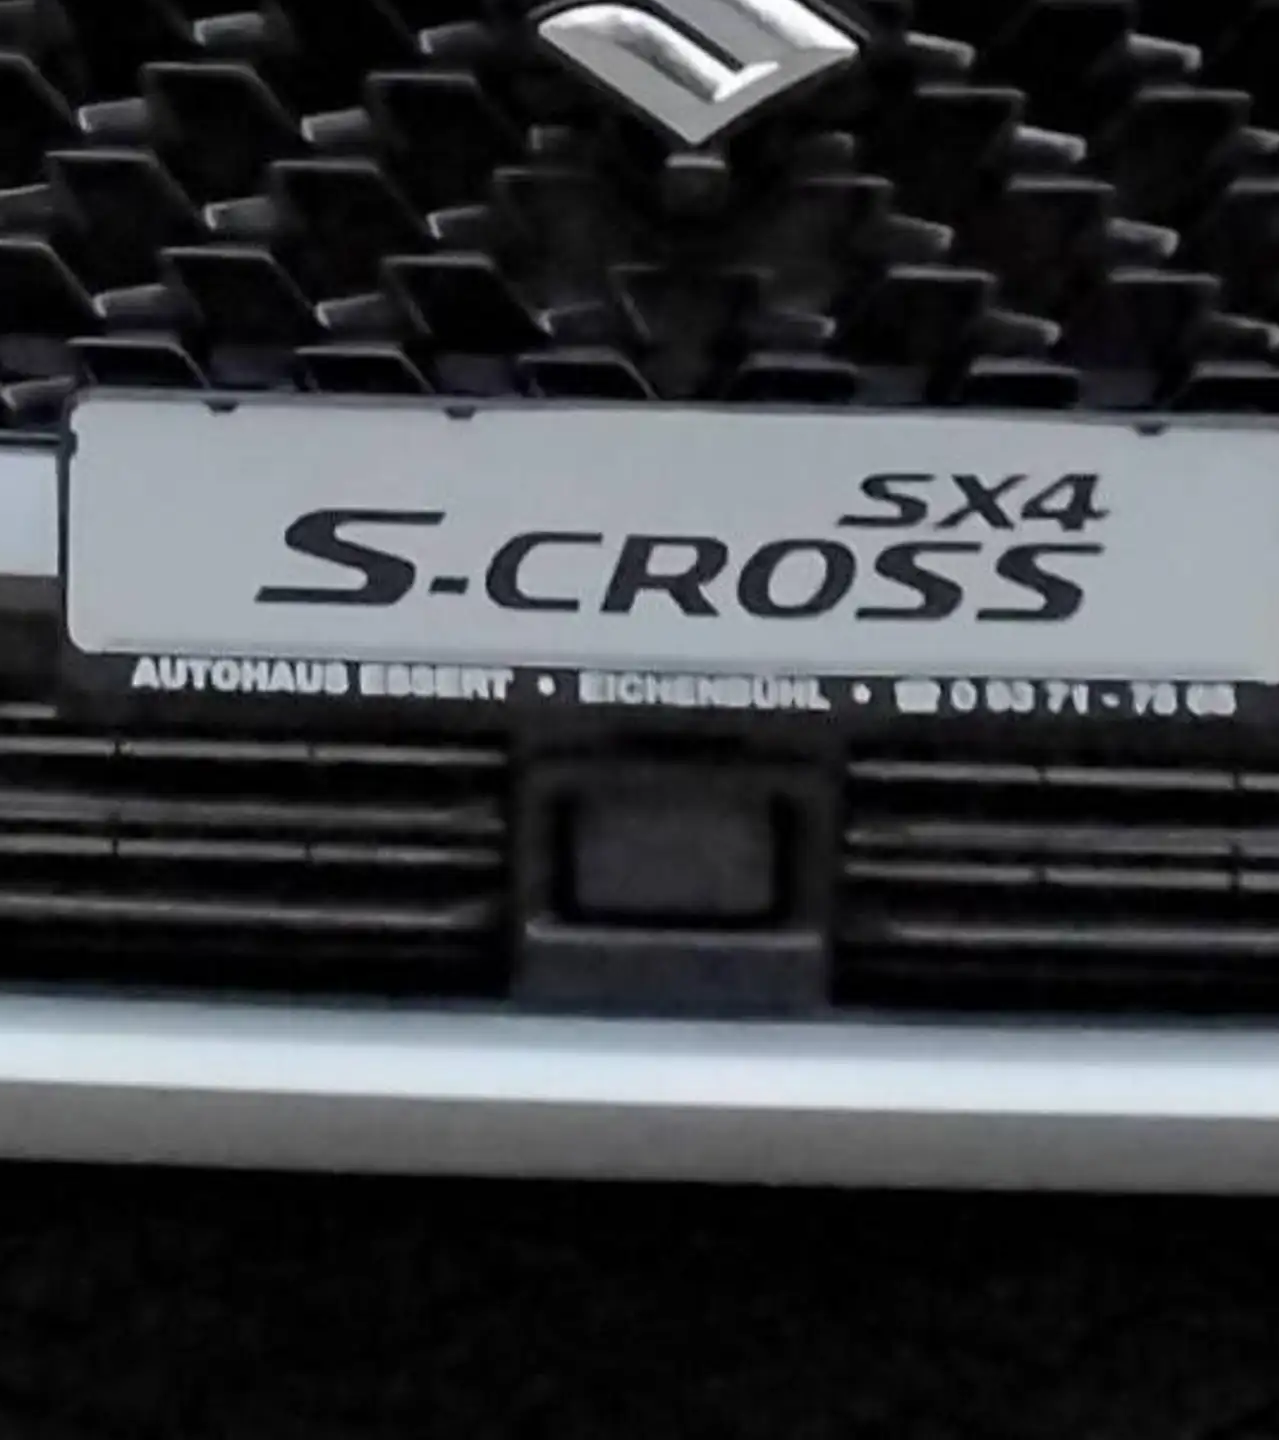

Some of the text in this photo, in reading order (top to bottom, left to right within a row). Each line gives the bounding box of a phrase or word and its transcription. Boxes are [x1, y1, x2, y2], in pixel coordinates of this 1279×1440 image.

[836, 471, 1111, 531] SX4
[254, 507, 1105, 622] S-CROSS
[131, 657, 349, 695] AUTOHAUS
